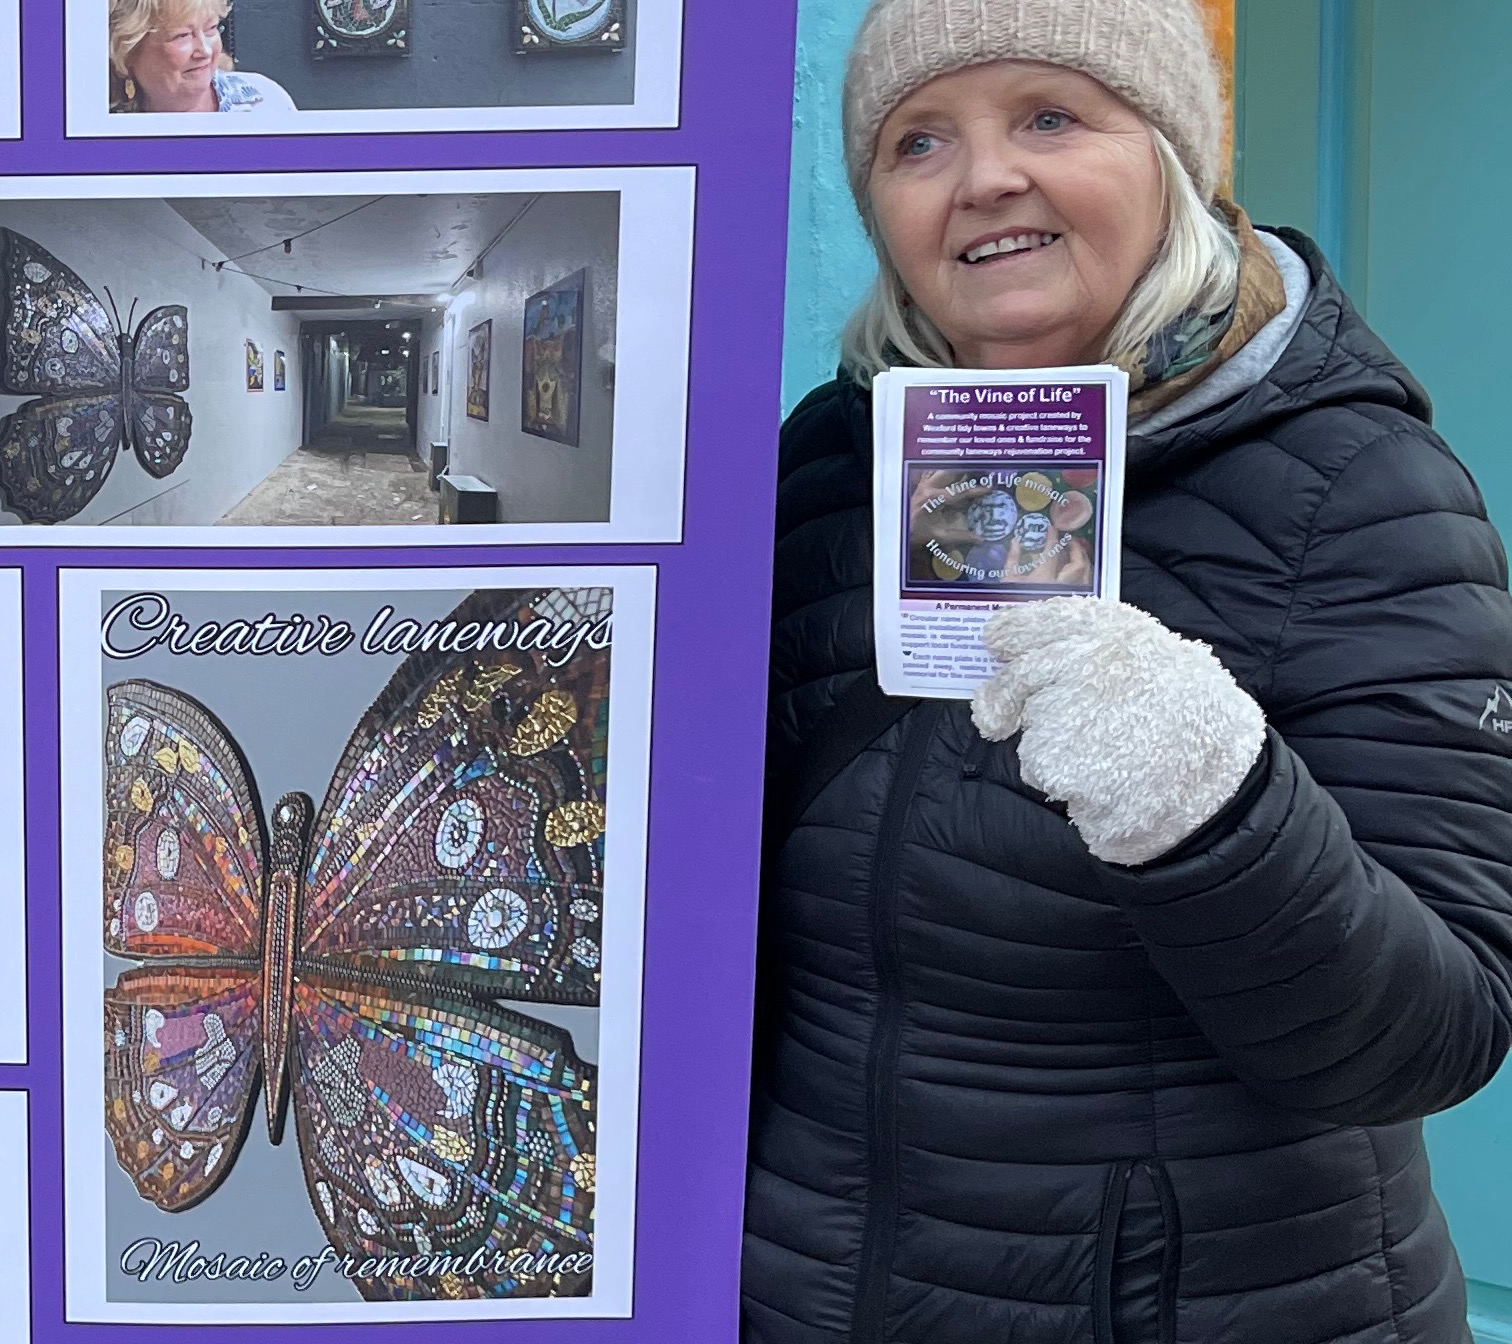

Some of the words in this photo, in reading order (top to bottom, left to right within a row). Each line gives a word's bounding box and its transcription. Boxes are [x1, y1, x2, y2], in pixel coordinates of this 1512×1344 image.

[927, 412, 934, 420] A
[1071, 411, 1082, 420] by
[974, 388, 1014, 403] Vine
[1017, 387, 1037, 403] of
[921, 494, 946, 514] The
[945, 478, 977, 497] Vine
[980, 472, 995, 488] of
[997, 471, 1022, 488] Life
[1024, 478, 1070, 507] mosaic
[925, 538, 986, 580] Honouring
[988, 567, 1011, 578] our
[1013, 553, 1048, 575] loved
[1048, 532, 1073, 558] ones
[936, 602, 942, 610] A
[99, 591, 355, 659] Creative
[361, 604, 614, 667] laneways
[119, 1236, 288, 1284] Mosaic
[290, 1245, 340, 1292] of
[335, 1246, 595, 1281] remembrance
